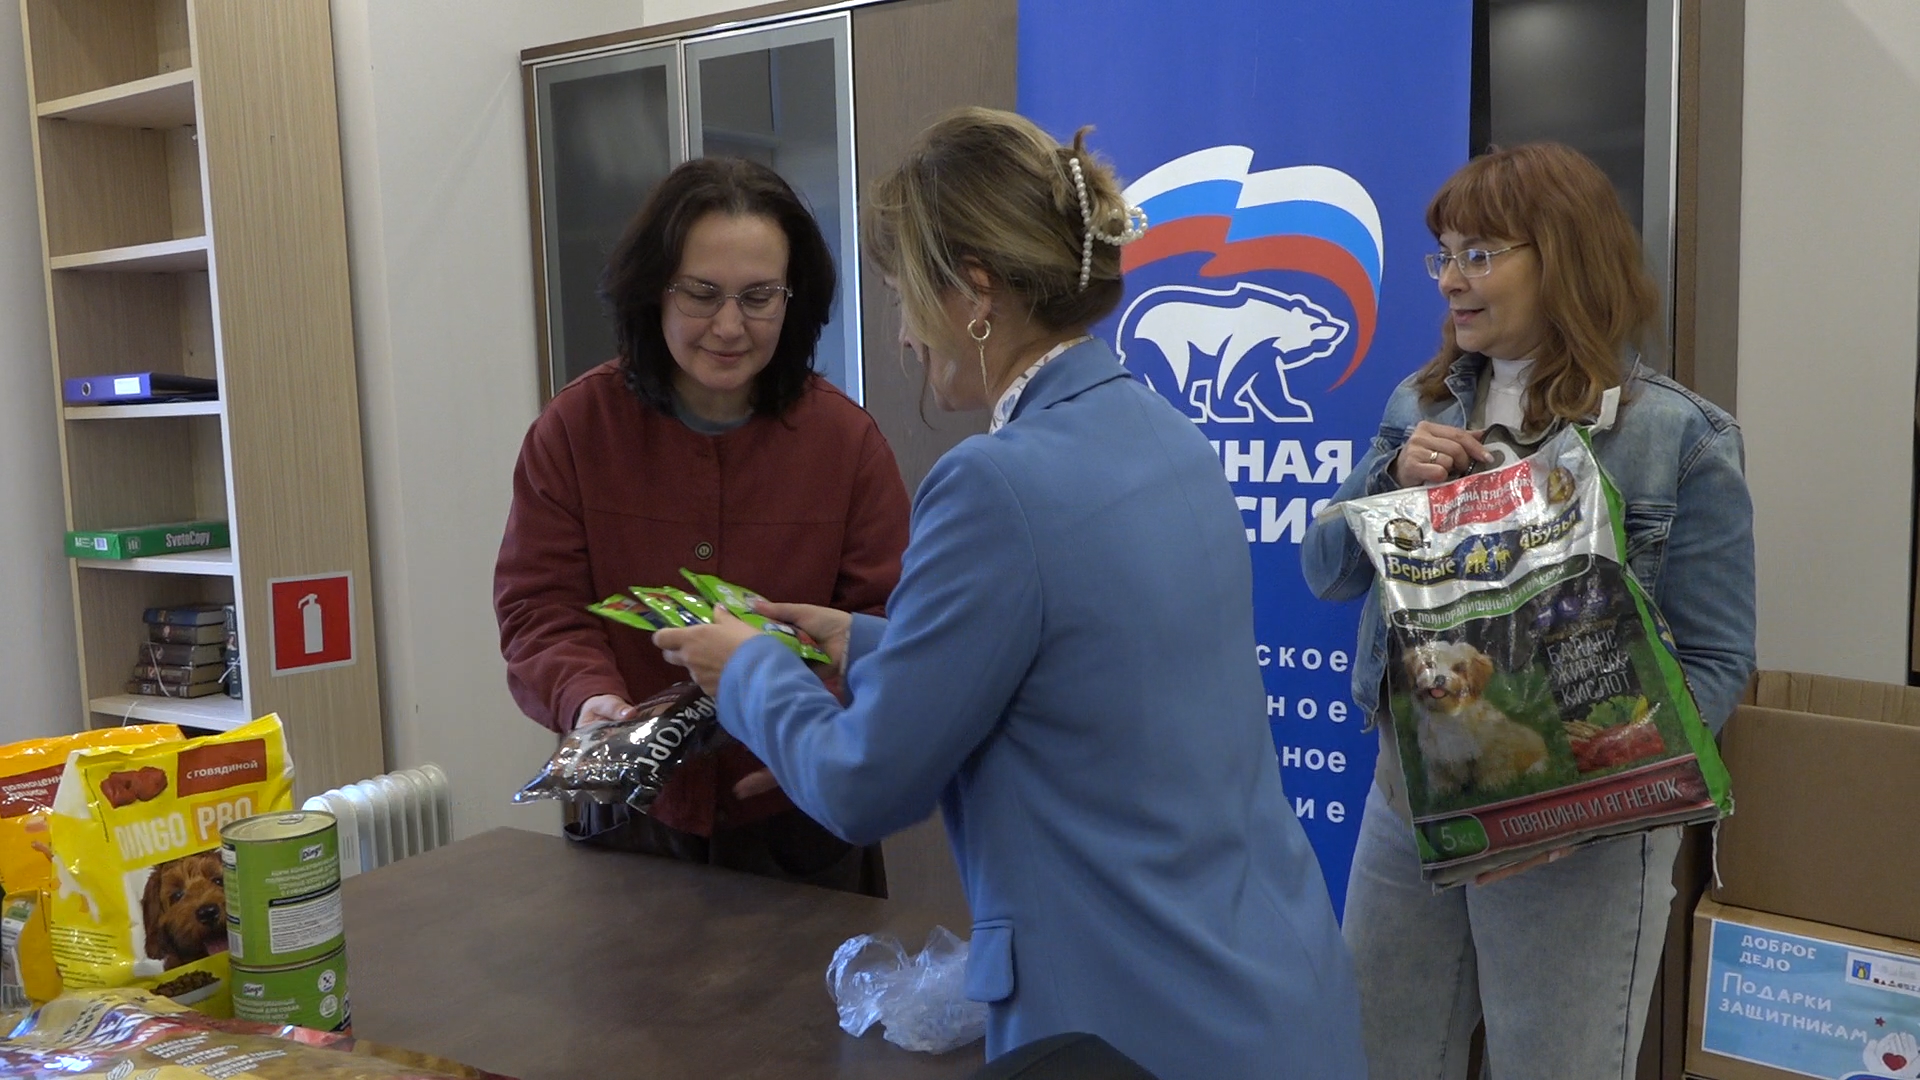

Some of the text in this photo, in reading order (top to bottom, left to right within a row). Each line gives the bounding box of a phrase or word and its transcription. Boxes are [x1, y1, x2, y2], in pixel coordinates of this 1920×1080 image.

[1210, 440, 1352, 483] НАЯ
[166, 531, 211, 548] SvetoCopy
[1389, 556, 1456, 582] Верные
[1256, 644, 1349, 672] ское
[1547, 629, 1618, 665] БАЛАНС
[1553, 650, 1627, 685] ЖИРНЫХ
[1561, 671, 1630, 706] КИСЛОТ
[1267, 695, 1348, 723] ное
[1276, 746, 1347, 773] ное
[1296, 797, 1346, 824] ие
[1500, 777, 1683, 837] ГОВЯДИНА И ЯГНЕНОК
[114, 796, 253, 862] DINGO PRO
[1740, 934, 1817, 960] ДОБРОЕ
[1739, 951, 1791, 972] ДЕЛО
[1718, 998, 1868, 1043] ЗАЩИТНИКАМ
